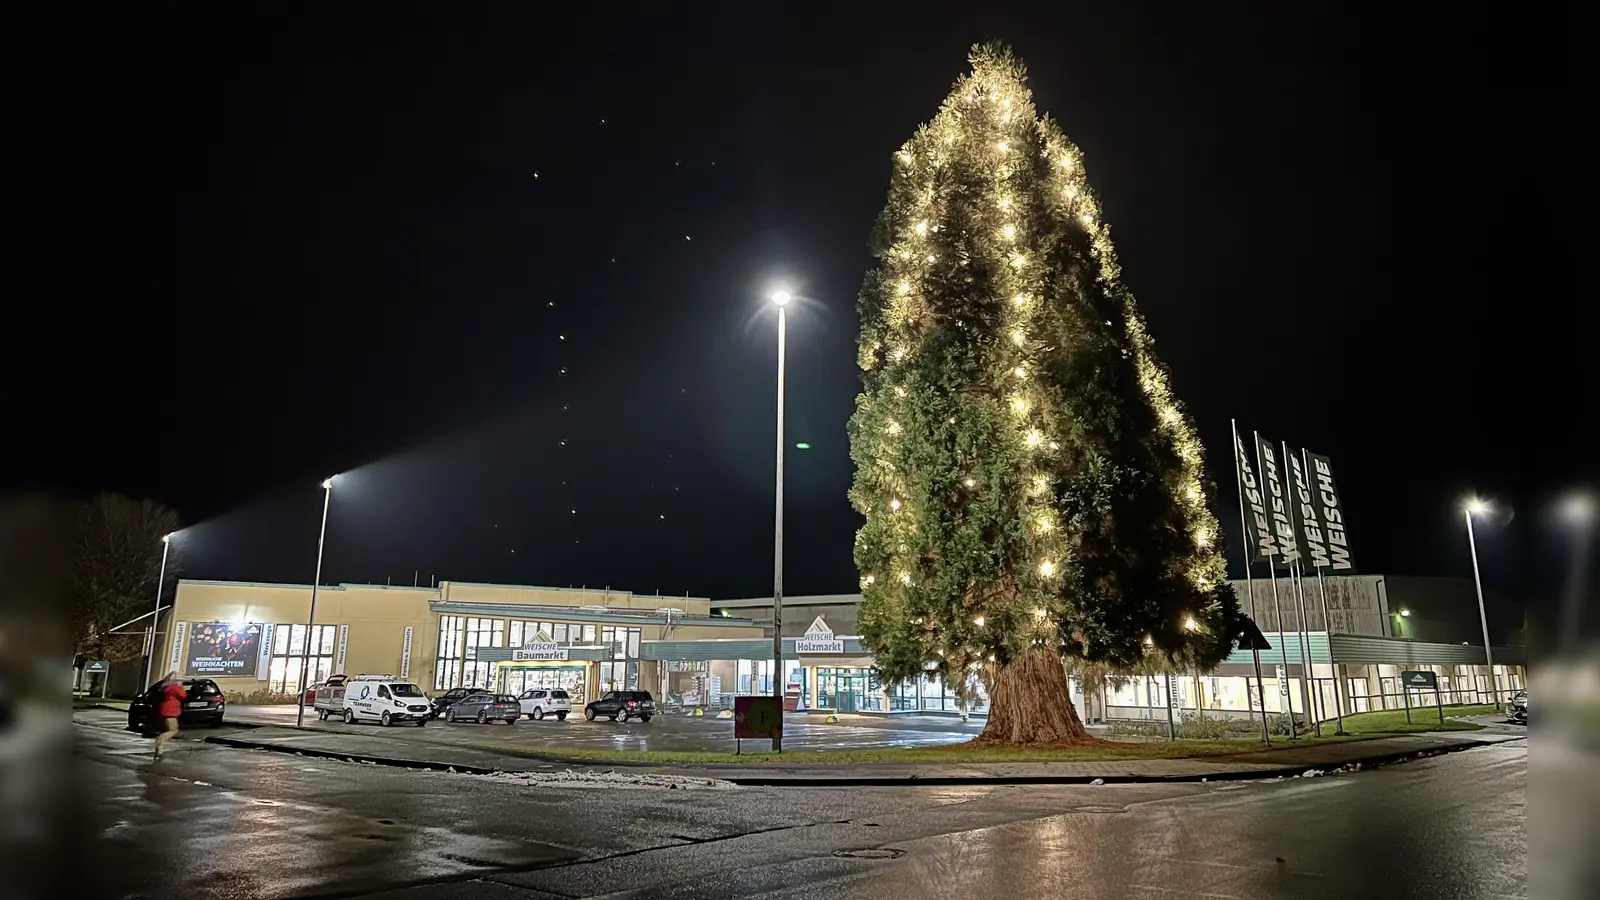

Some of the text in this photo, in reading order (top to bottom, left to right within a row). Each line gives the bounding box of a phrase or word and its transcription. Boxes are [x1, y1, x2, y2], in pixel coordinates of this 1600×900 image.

[1290, 453, 1330, 567] WEISCHE
[1314, 458, 1352, 570] WEISCHE
[797, 642, 841, 651] Holzmarkt
[805, 633, 832, 641] WEISCHE
[516, 651, 564, 660] Baumarkt
[1279, 665, 1288, 697] Garten
